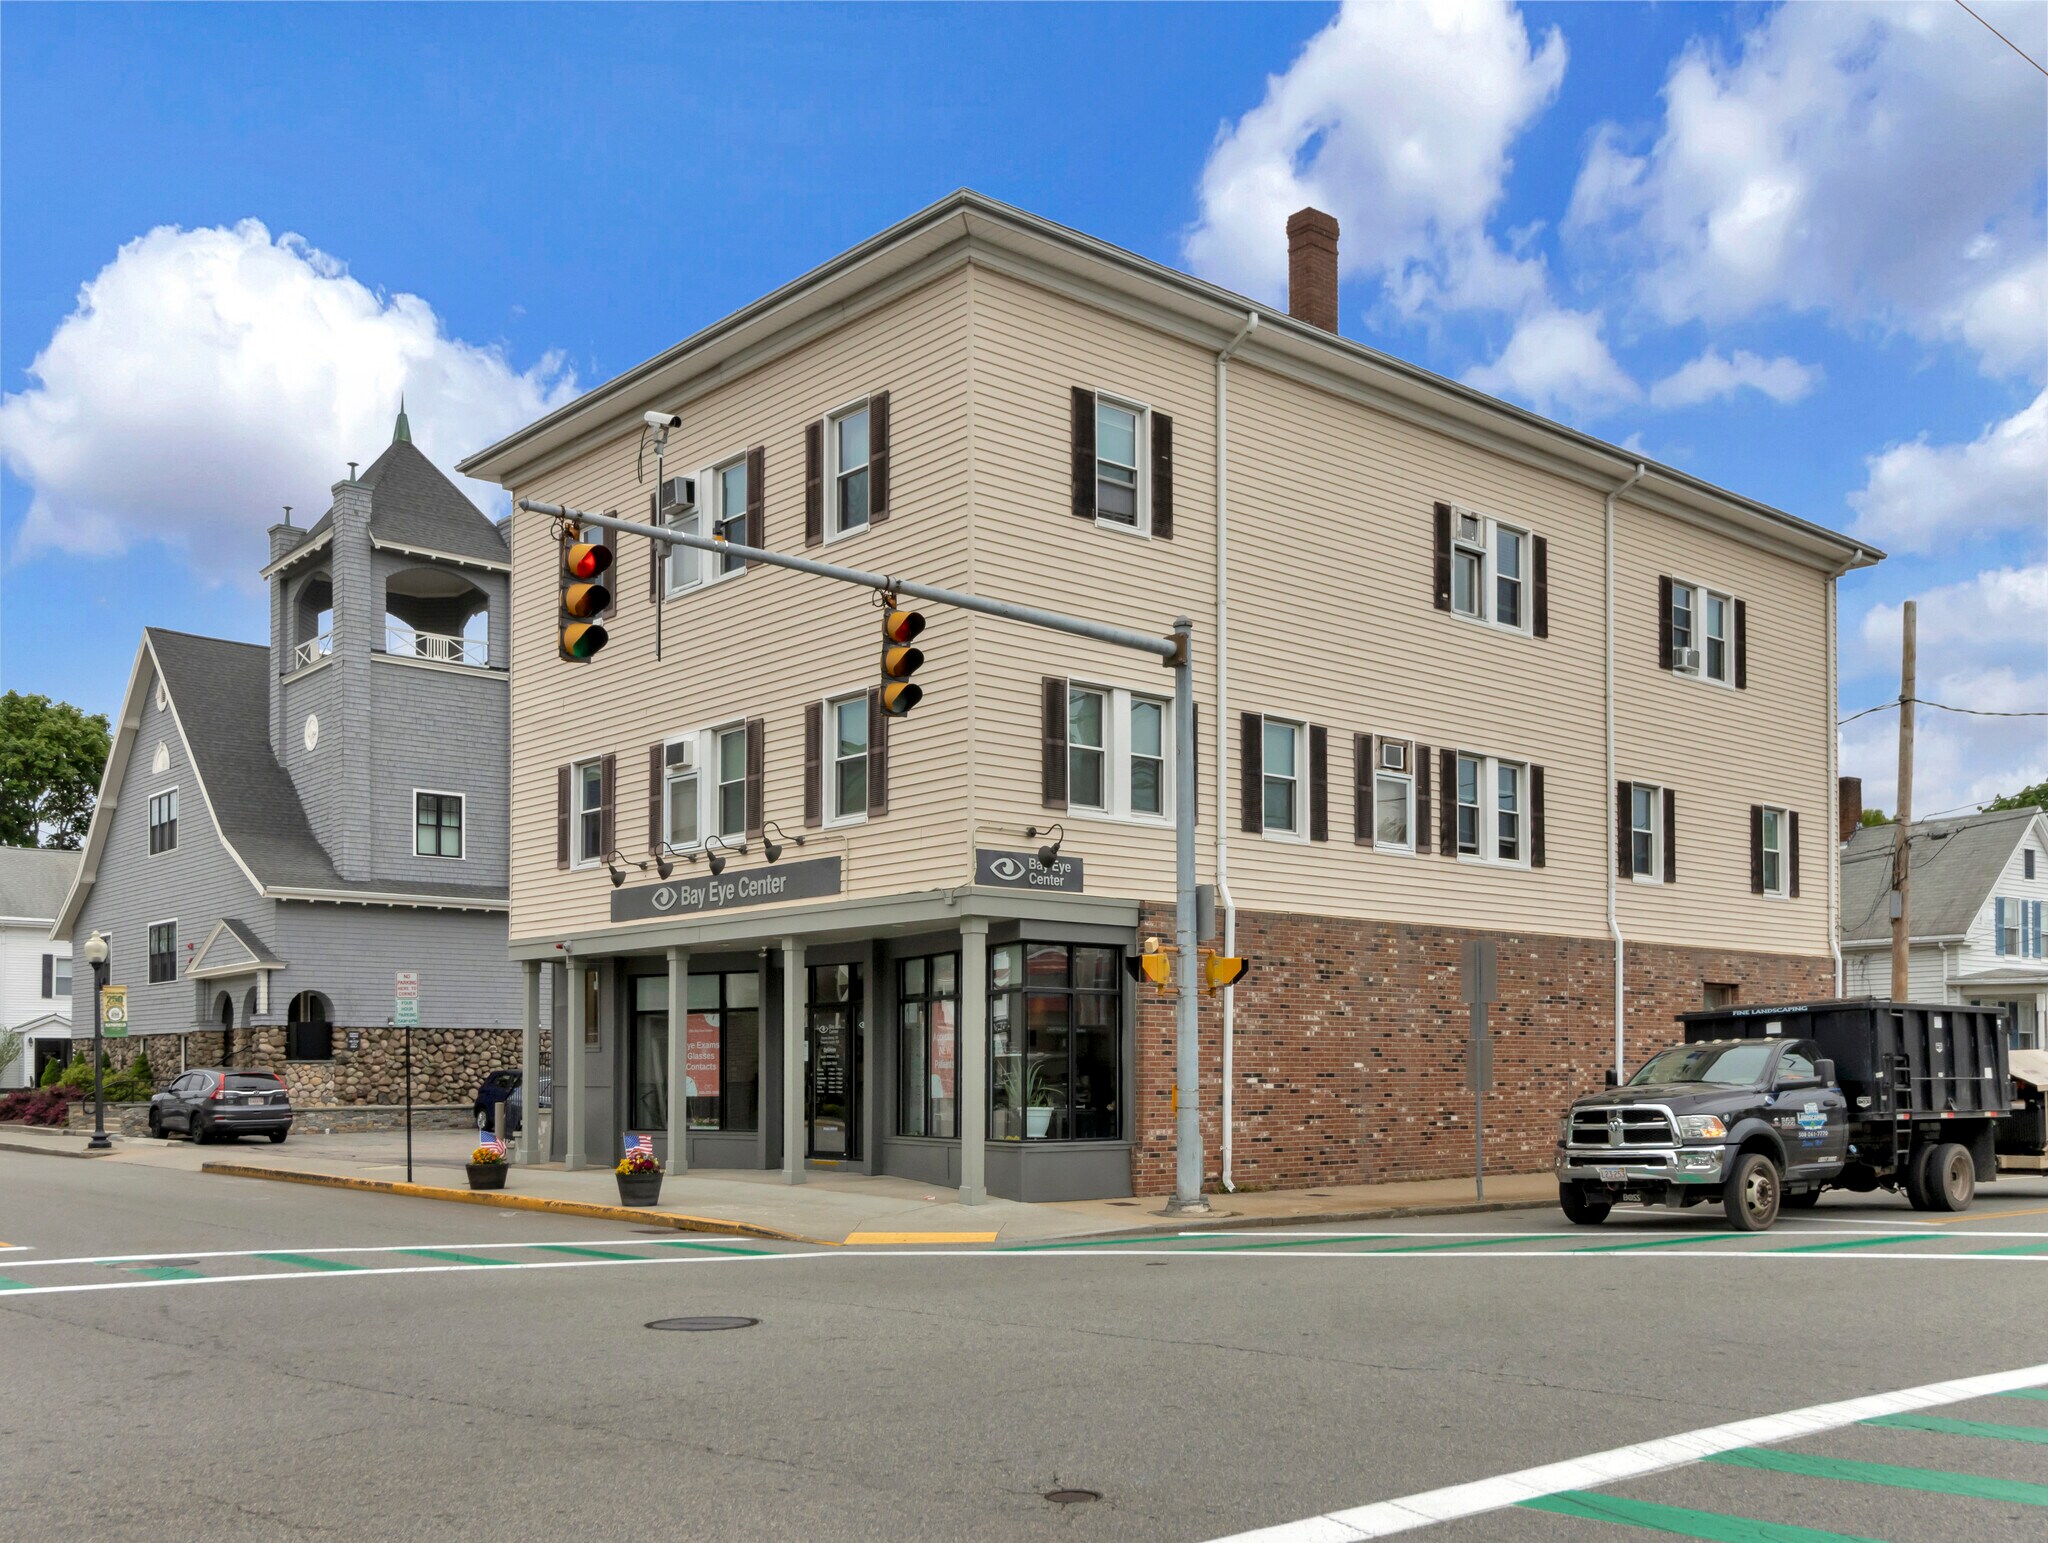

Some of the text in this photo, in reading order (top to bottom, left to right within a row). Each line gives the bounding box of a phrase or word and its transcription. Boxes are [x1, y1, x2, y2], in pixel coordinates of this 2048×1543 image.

[1052, 860, 1072, 874] Eye
[1029, 872, 1064, 886] Center
[681, 874, 787, 908] Bay Eye Center
[1751, 1006, 1808, 1015] LANDSCAPING
[688, 1052, 715, 1060] Glasses
